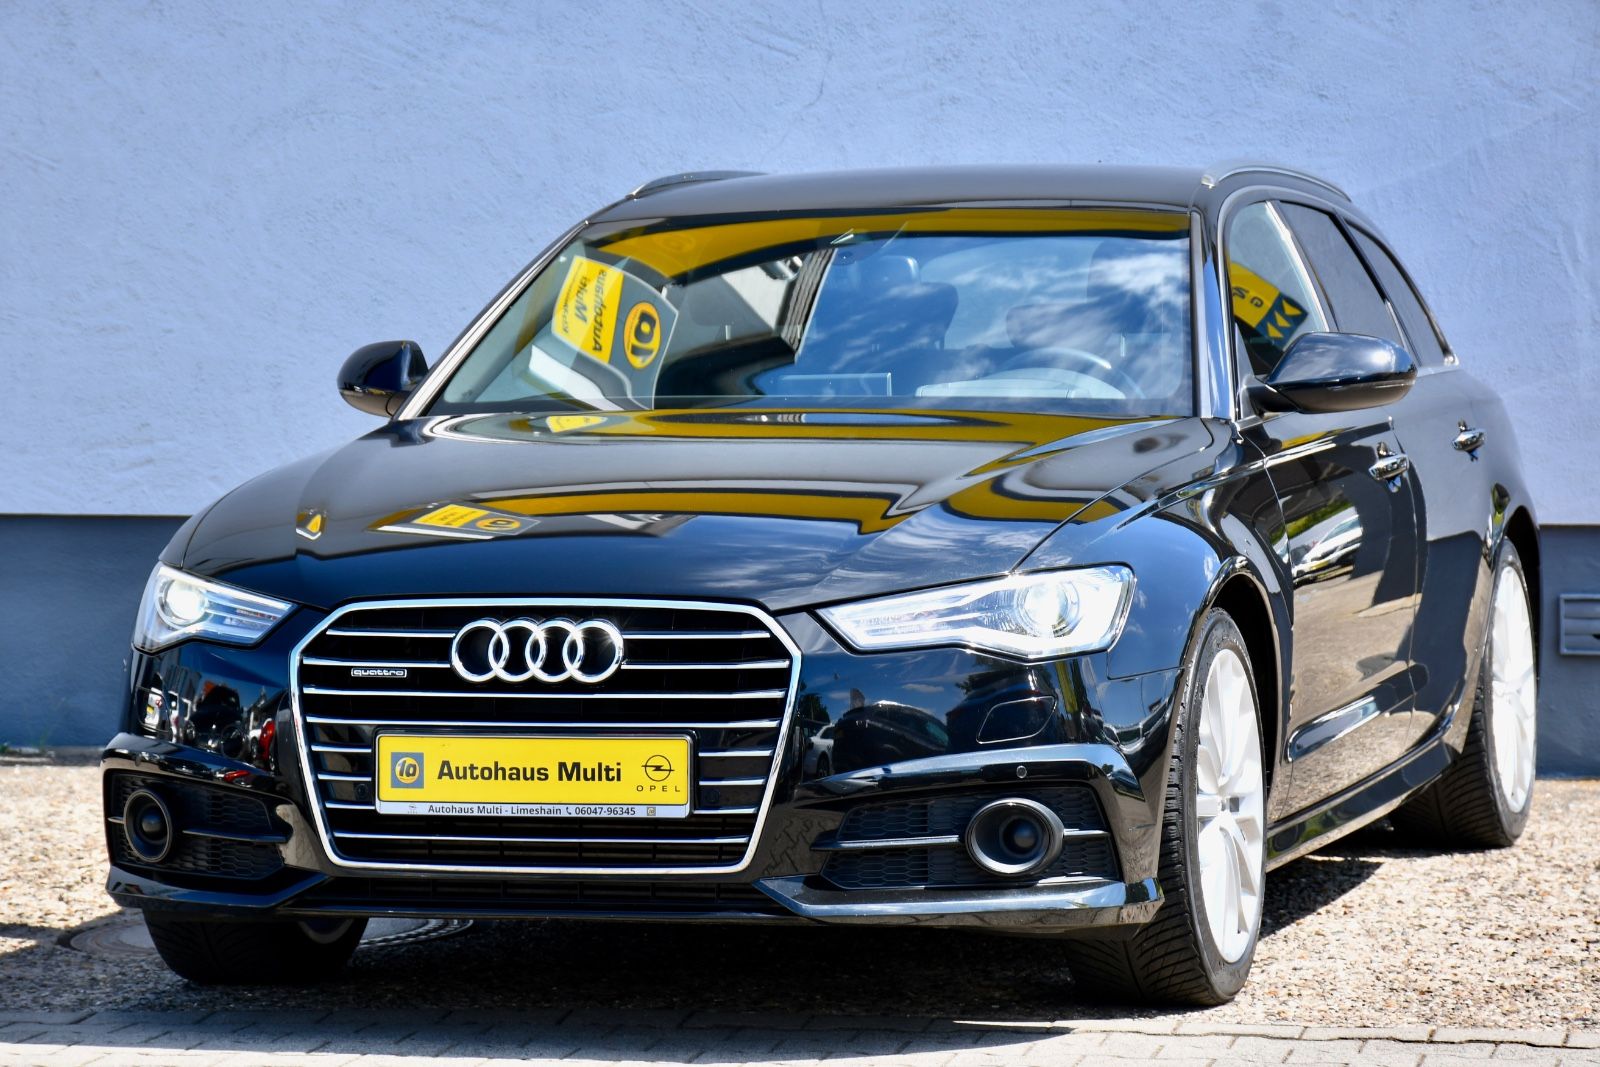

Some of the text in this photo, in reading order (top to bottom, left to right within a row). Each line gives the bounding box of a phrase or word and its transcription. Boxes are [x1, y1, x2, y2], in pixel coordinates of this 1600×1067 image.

[437, 760, 549, 781] Autohaus
[557, 762, 621, 782] Multi
[428, 804, 474, 814] Autohaus
[477, 806, 503, 814] Multi
[510, 806, 562, 815] Limeshain
[574, 806, 636, 816] 06047-96345
